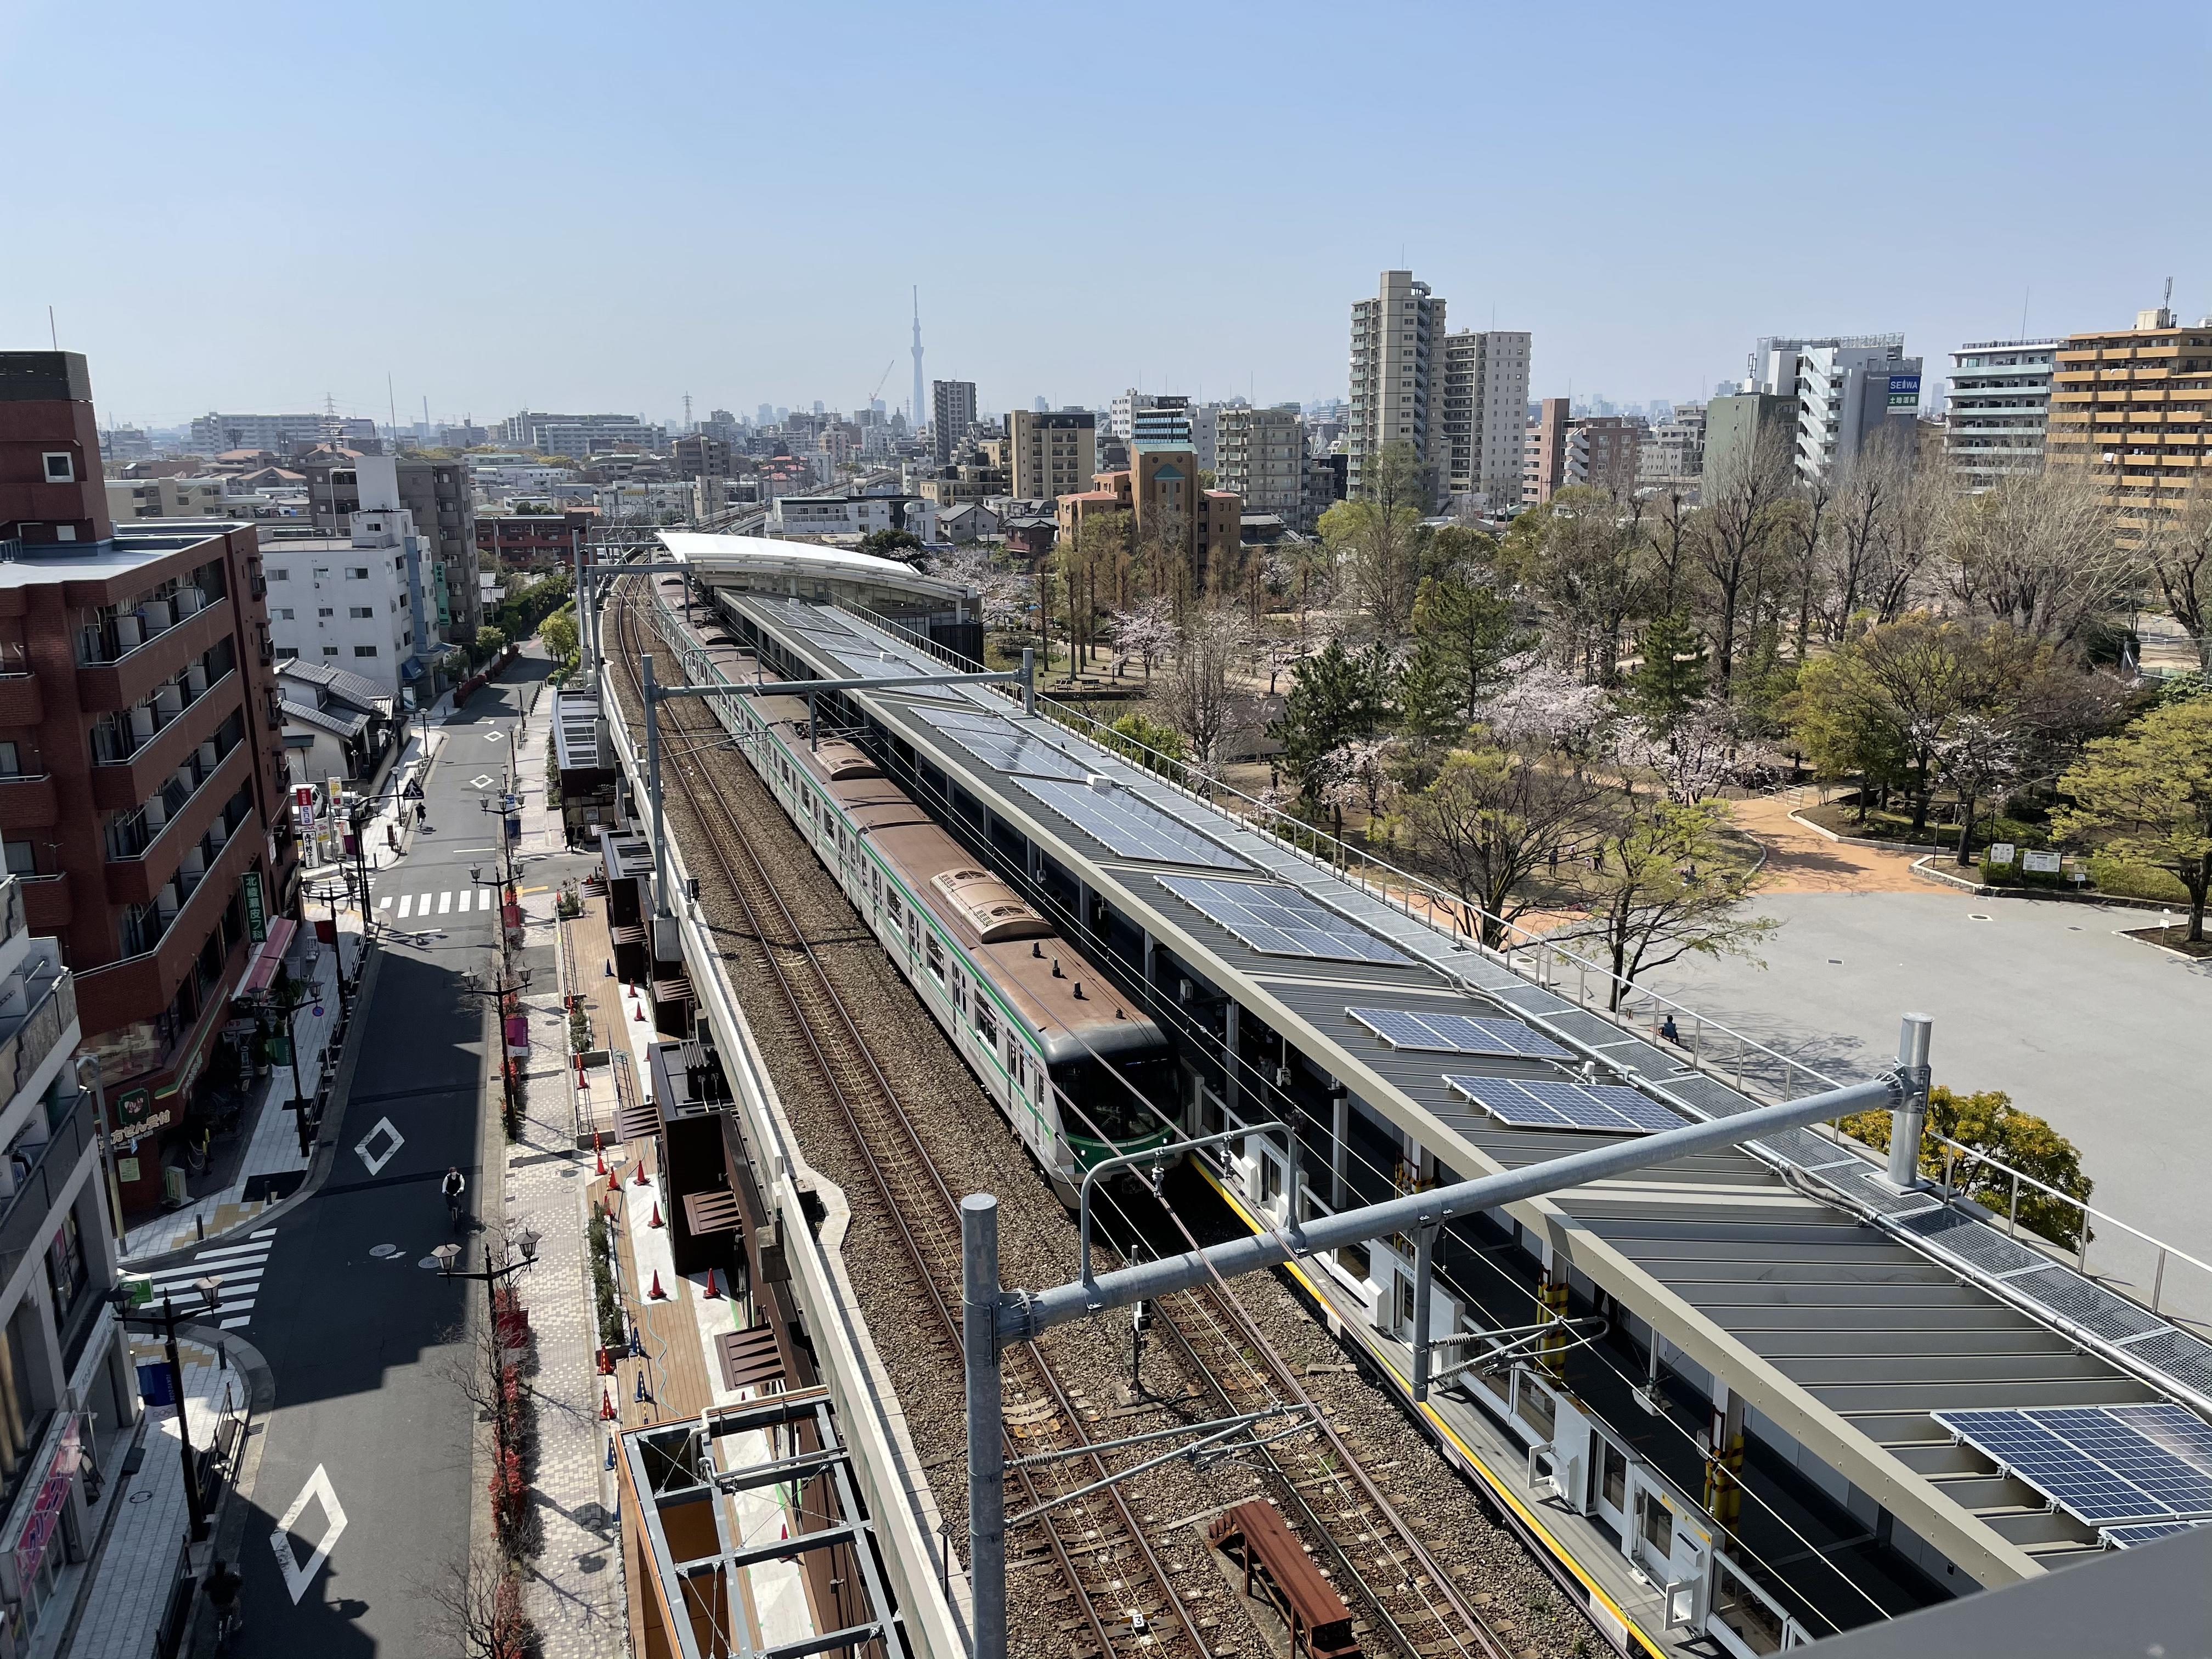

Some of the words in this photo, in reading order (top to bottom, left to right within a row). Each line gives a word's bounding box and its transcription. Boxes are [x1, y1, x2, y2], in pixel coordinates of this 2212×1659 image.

[1890, 379, 1917, 389] SEIWA
[331, 784, 340, 795] P
[943, 1524, 949, 1533] 3
[1135, 1616, 1142, 1625] 3
